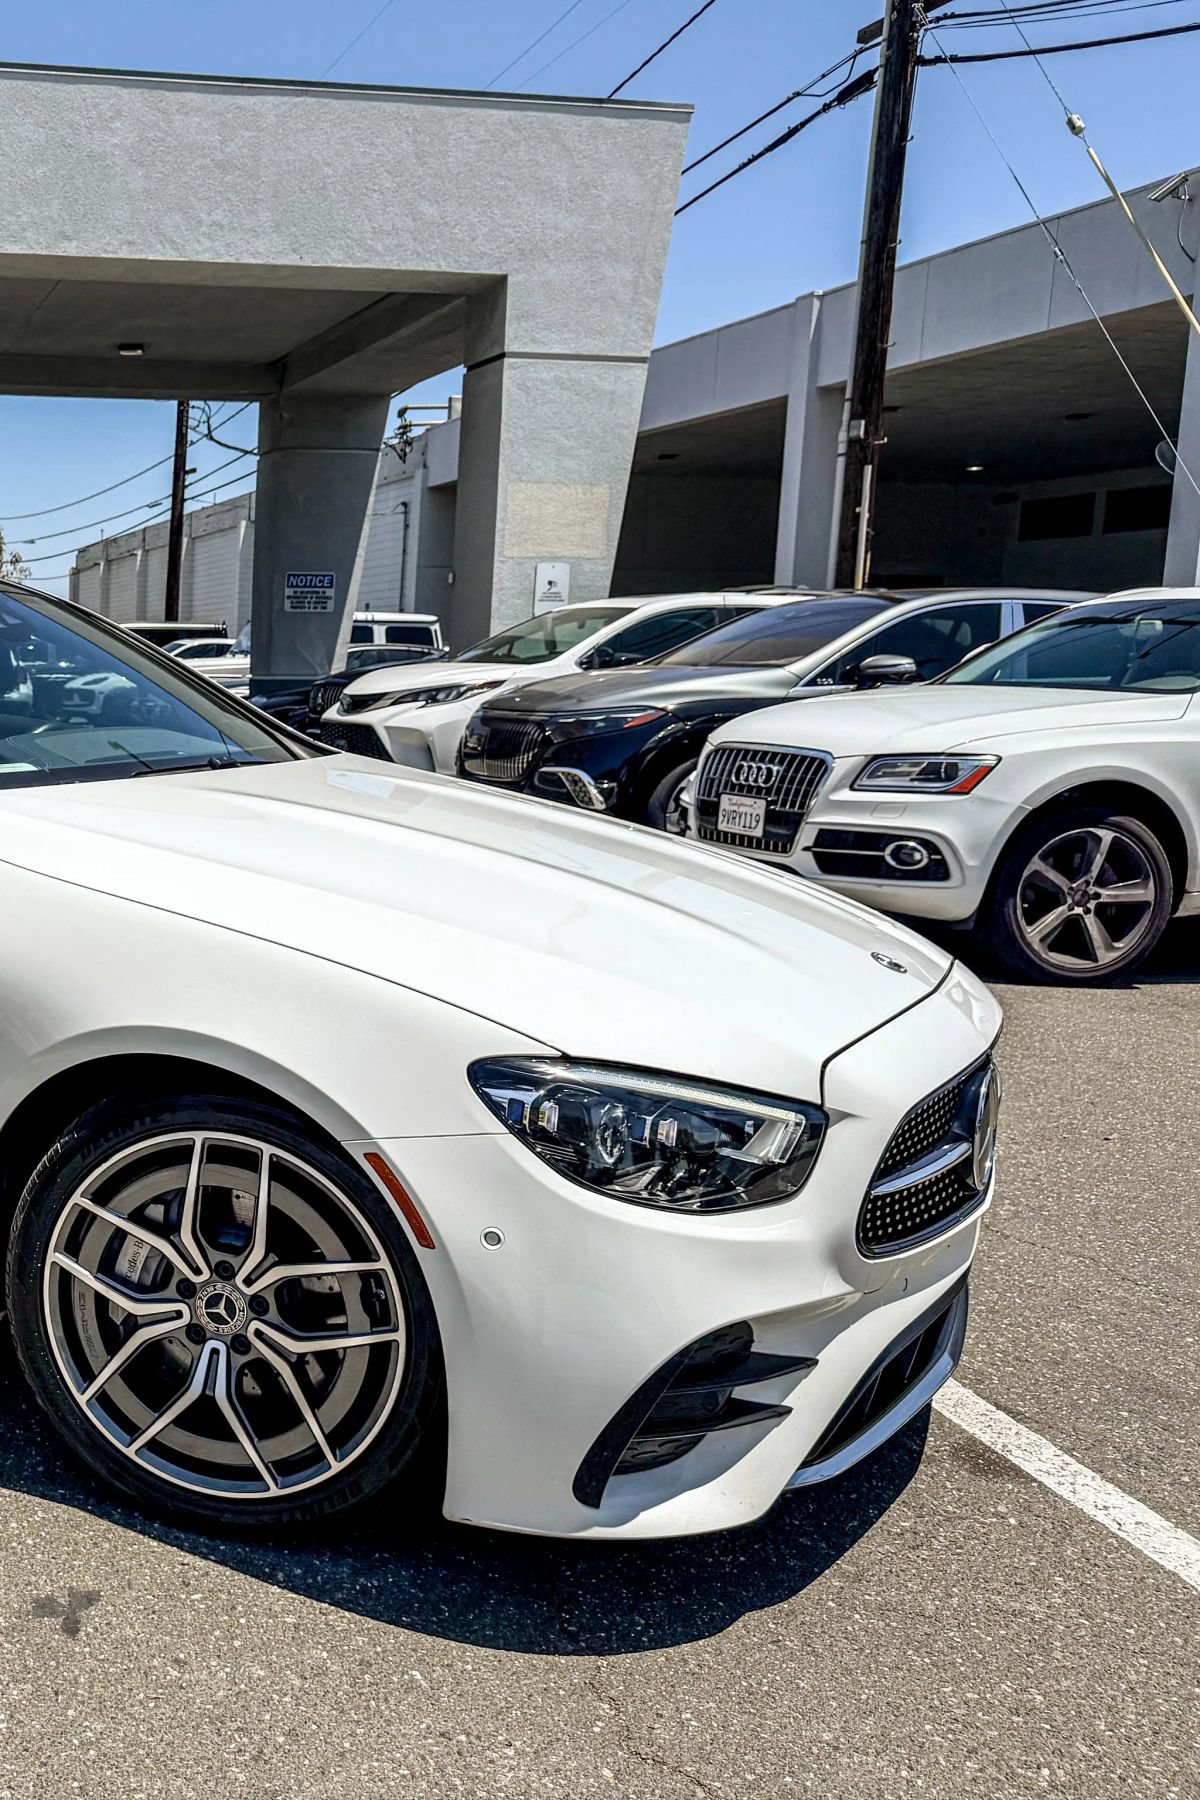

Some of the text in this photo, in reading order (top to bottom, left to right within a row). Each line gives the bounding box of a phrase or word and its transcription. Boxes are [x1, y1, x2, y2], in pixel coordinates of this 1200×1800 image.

[288, 576, 332, 587] NOTICE
[720, 808, 761, 830] 9VRY119
[199, 1285, 215, 1300] BENZ
[218, 1311, 245, 1333] MERCEDES
